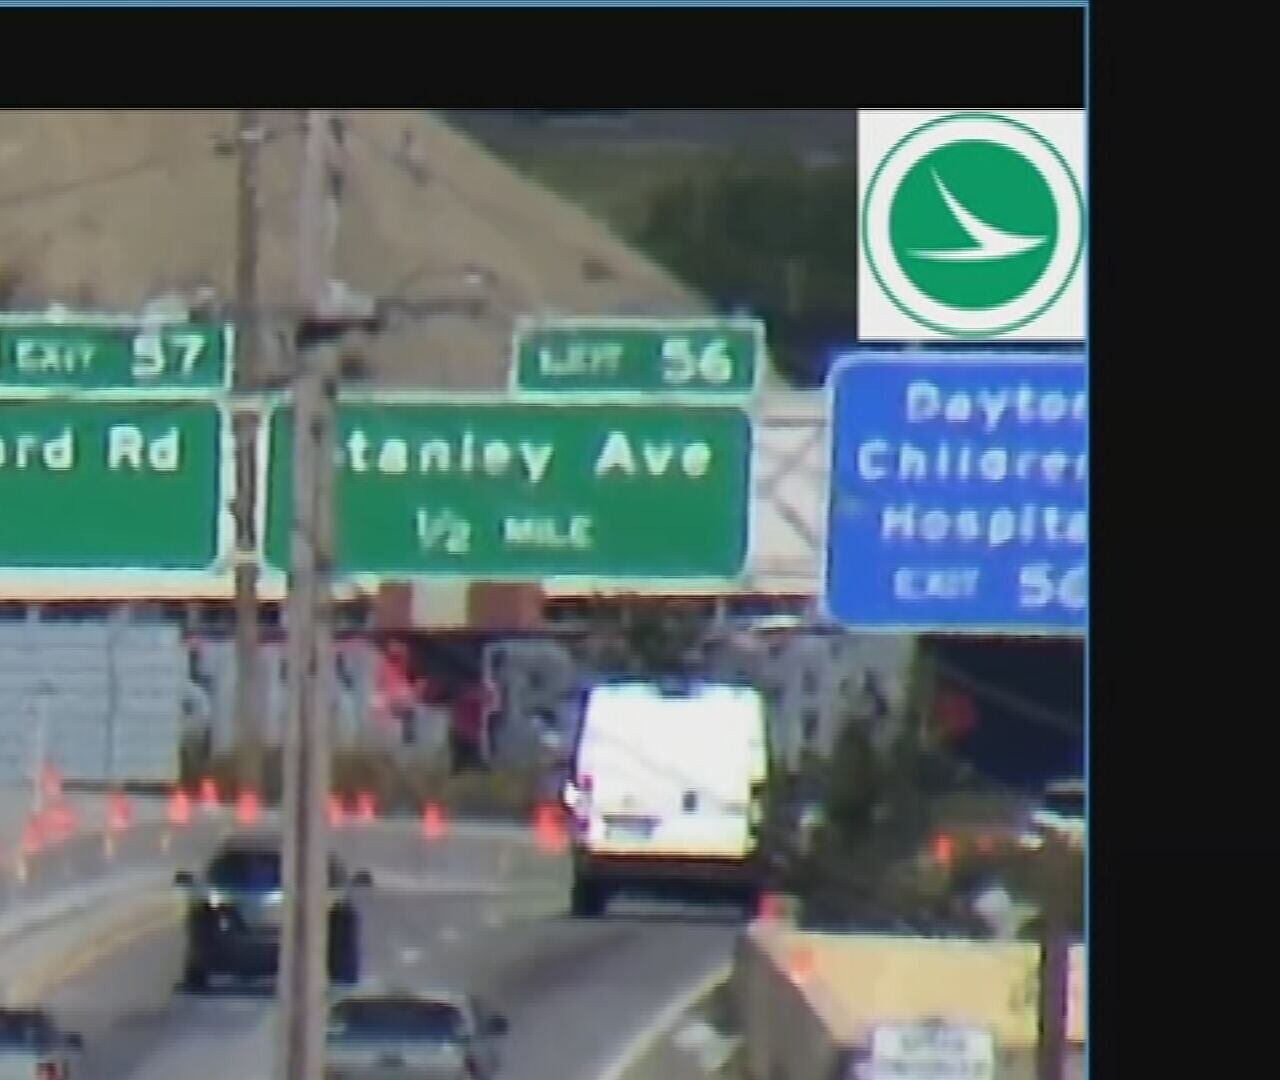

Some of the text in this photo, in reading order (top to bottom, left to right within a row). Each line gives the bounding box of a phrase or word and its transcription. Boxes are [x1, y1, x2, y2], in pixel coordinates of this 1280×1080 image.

[15, 333, 206, 377] EXIT 57
[660, 338, 733, 383] 56
[107, 423, 180, 471] Rd
[334, 428, 712, 482] tanley Ave
[502, 514, 594, 548] MILE
